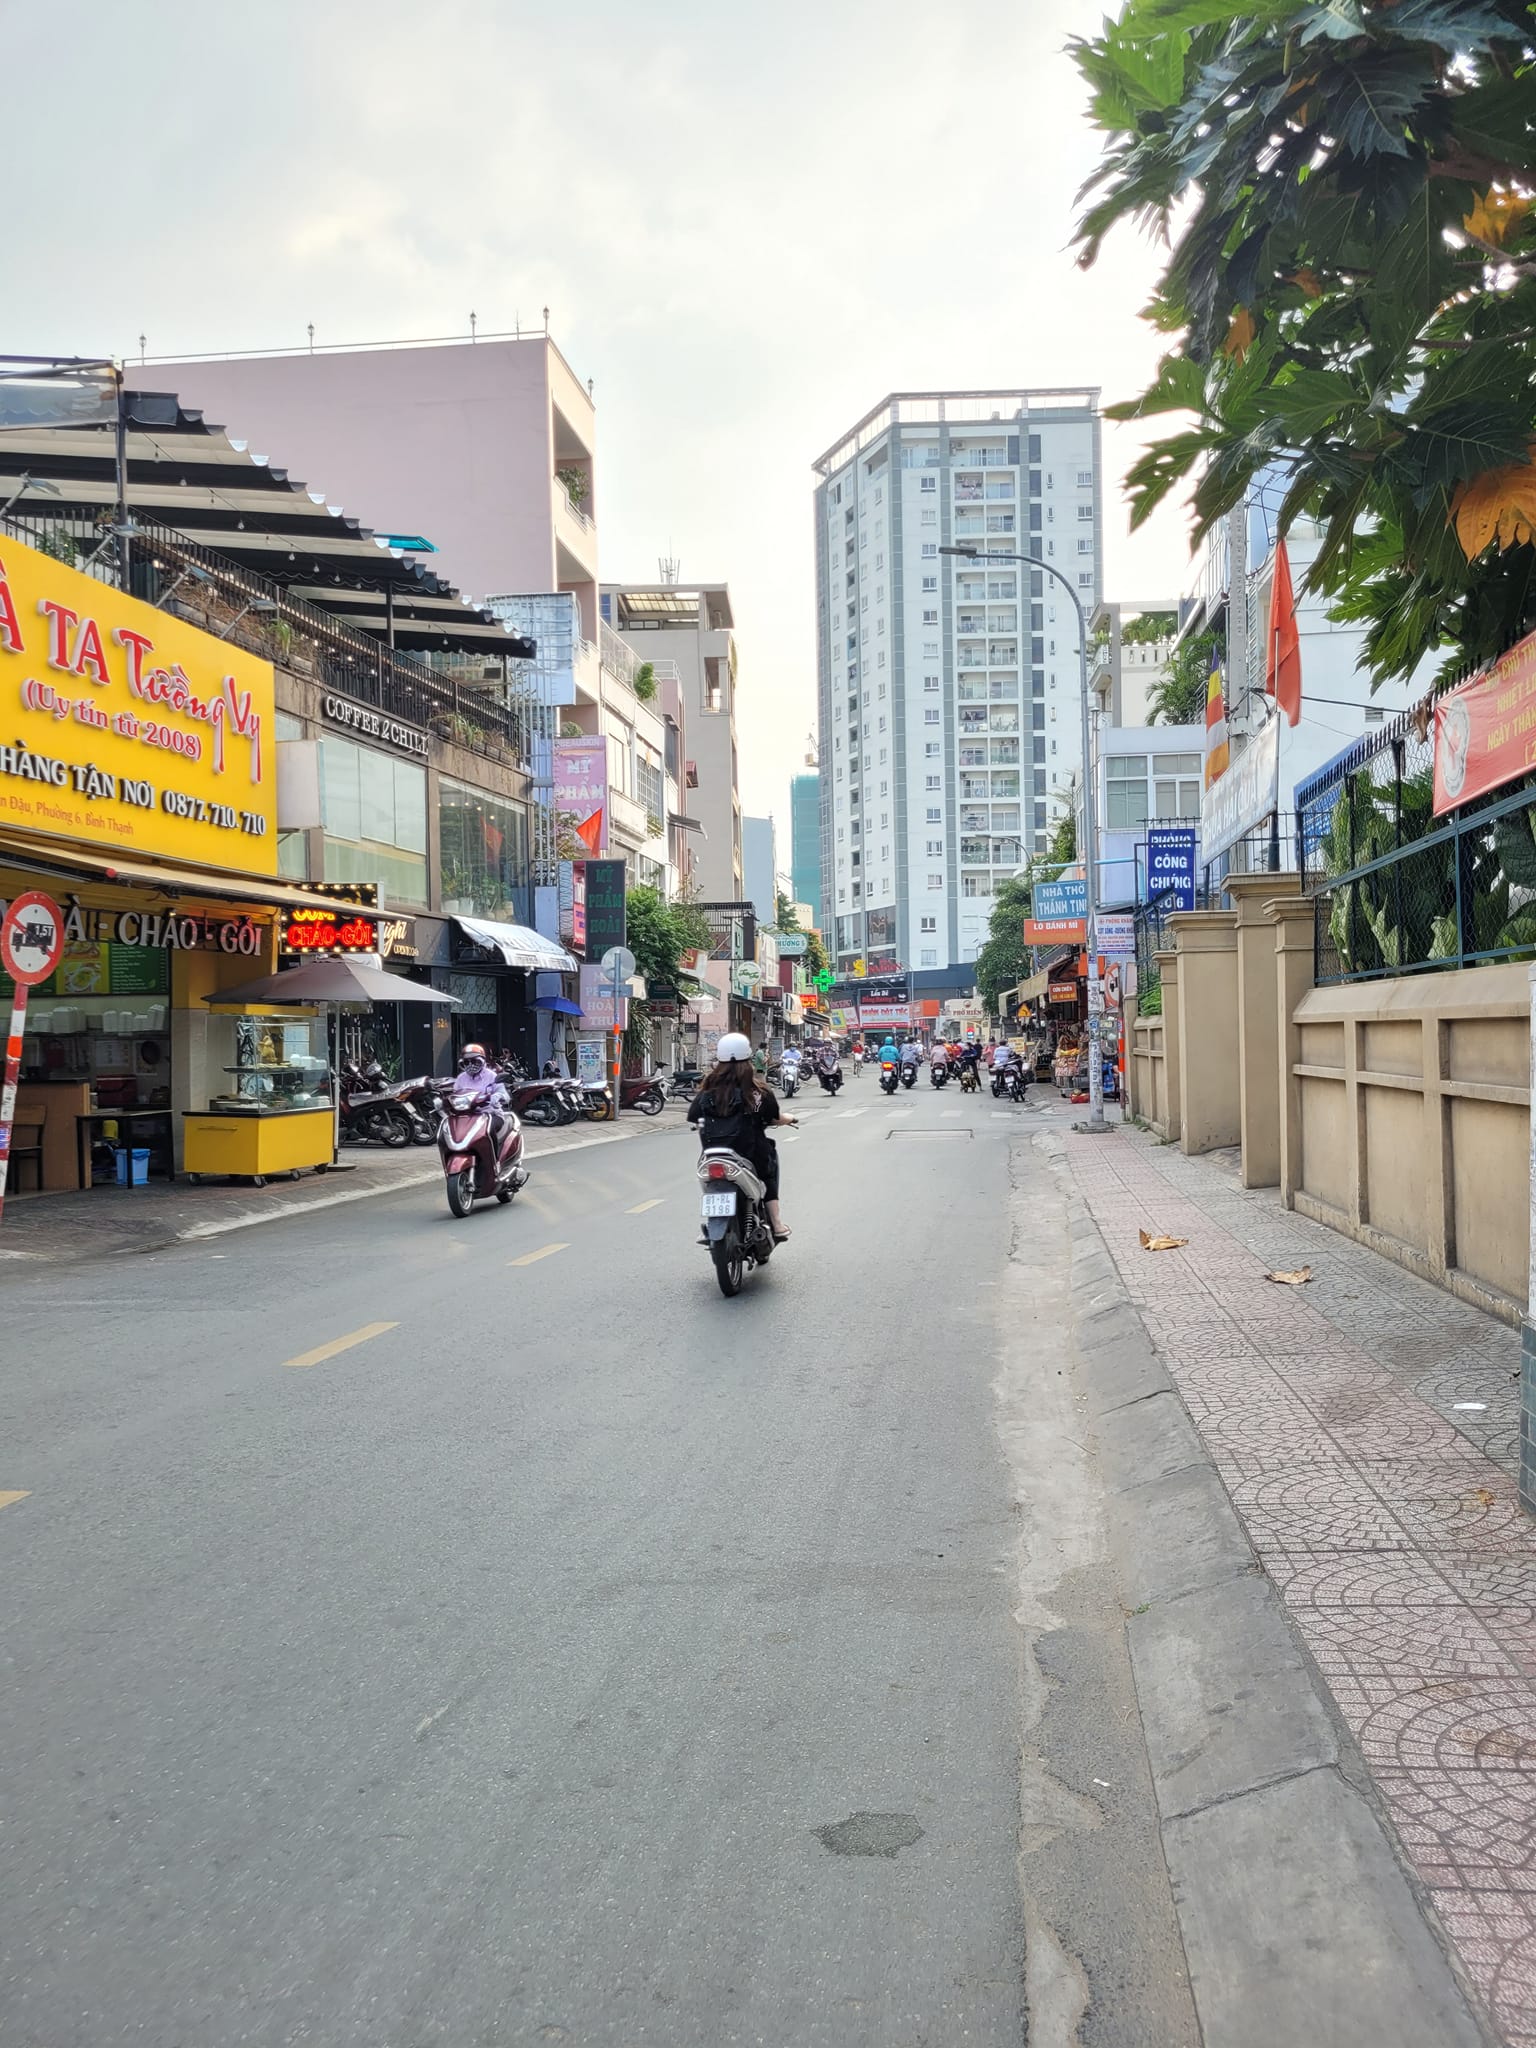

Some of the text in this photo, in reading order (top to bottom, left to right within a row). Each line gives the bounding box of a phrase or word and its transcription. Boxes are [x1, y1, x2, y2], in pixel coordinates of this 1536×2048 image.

[40, 599, 112, 684] TA
[224, 676, 262, 784] Vy
[21, 678, 70, 720] (Uy
[73, 699, 109, 730] tín
[142, 720, 202, 762] 2008)
[325, 695, 380, 735] COFFEE
[390, 723, 429, 756] CHILL
[0, 740, 68, 786] HÀNG
[69, 762, 116, 800] TẬN
[120, 777, 156, 810] NƠI
[1151, 832, 1191, 849] PHÒNG
[1154, 853, 1188, 869] CÔNG
[1150, 873, 1191, 889] CHỨNG
[1042, 884, 1063, 898] NHÀ
[1038, 898, 1087, 916] THÁNH TỊN
[1176, 896, 1184, 909] 6
[34, 925, 53, 937] 1,5T
[118, 908, 198, 950] CHÁO
